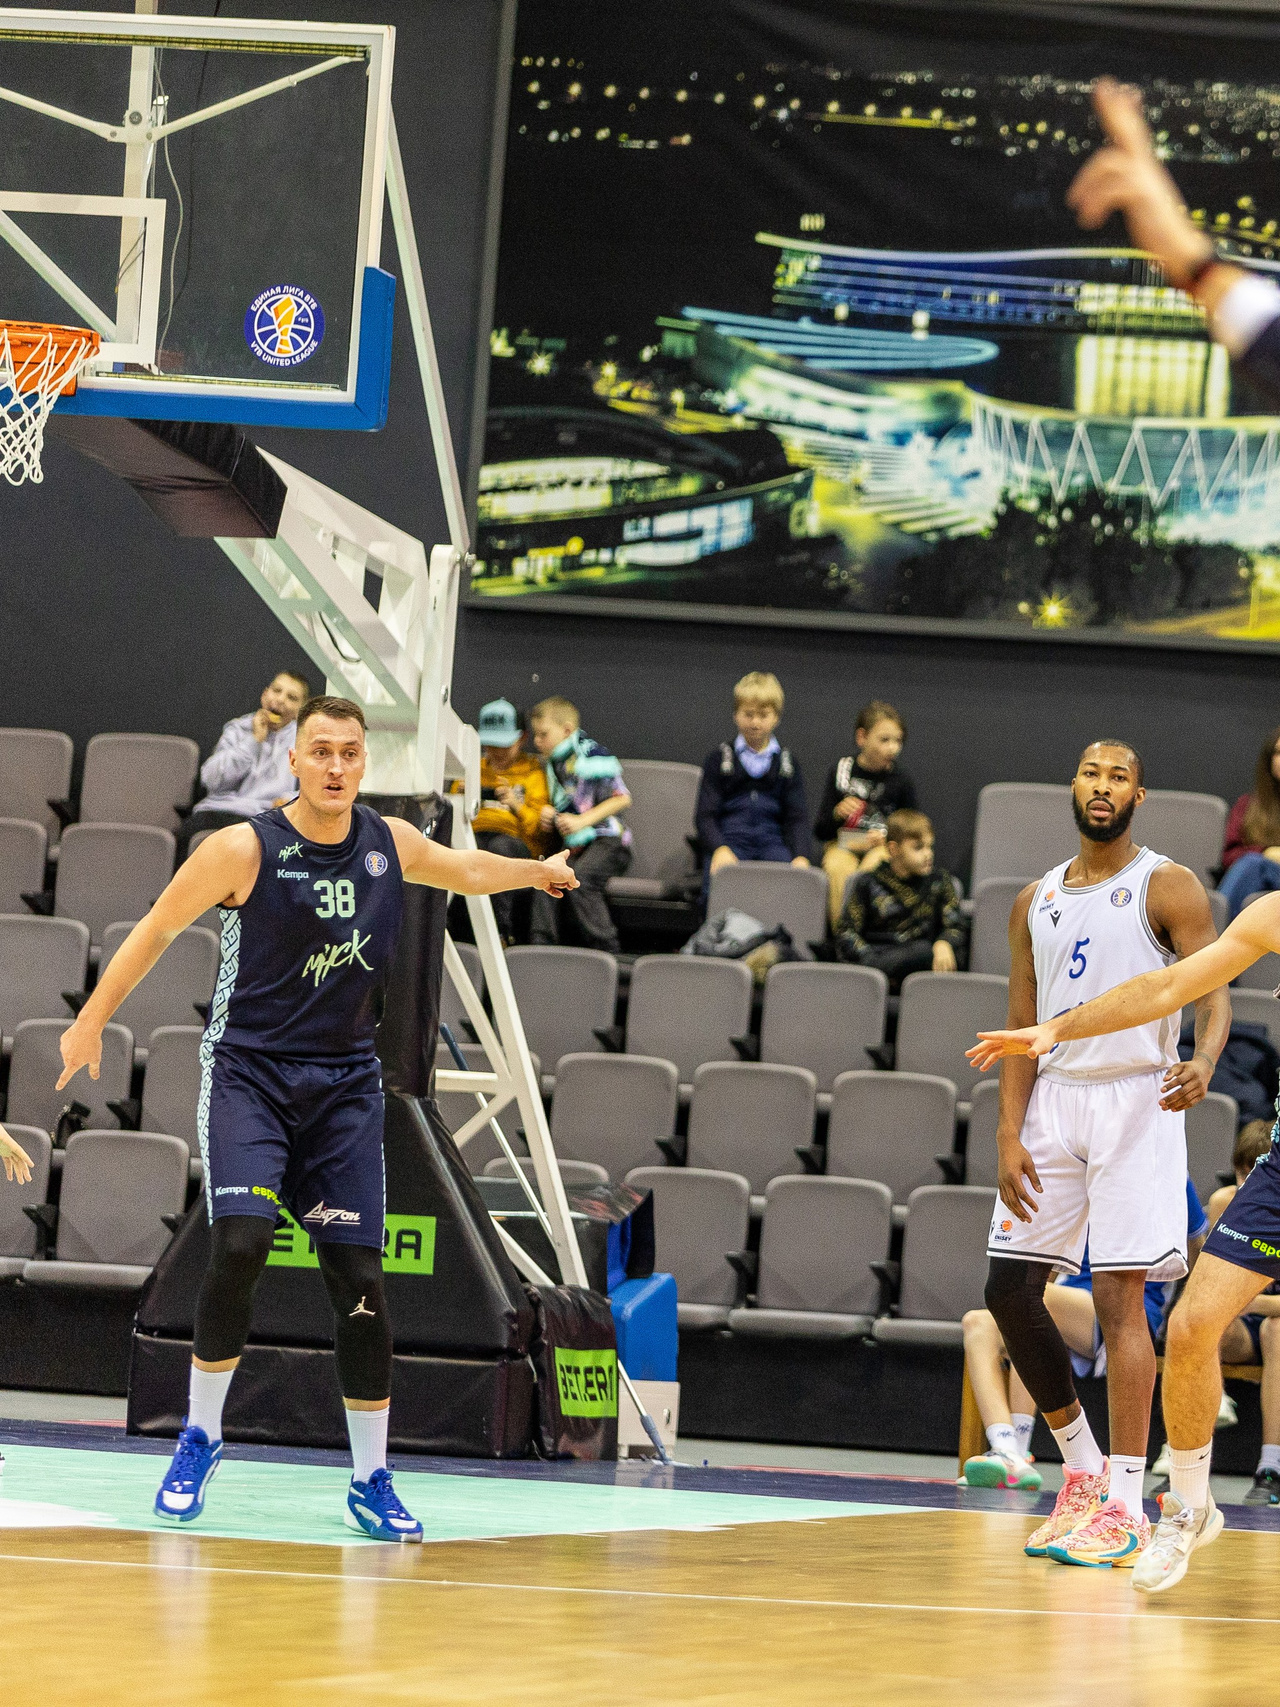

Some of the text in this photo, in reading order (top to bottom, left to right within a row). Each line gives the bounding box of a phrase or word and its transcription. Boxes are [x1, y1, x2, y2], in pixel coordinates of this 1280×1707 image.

[251, 286, 281, 312] ЕДИНАЯ
[283, 285, 304, 298] ЛИГА
[262, 354, 290, 367] UNITED
[291, 339, 318, 365] LEAGUE
[277, 869, 309, 880] Kempa
[313, 879, 356, 918] 38
[1069, 937, 1090, 979] 5
[215, 1186, 249, 1197] Kempa
[1217, 1223, 1250, 1243] Kempa
